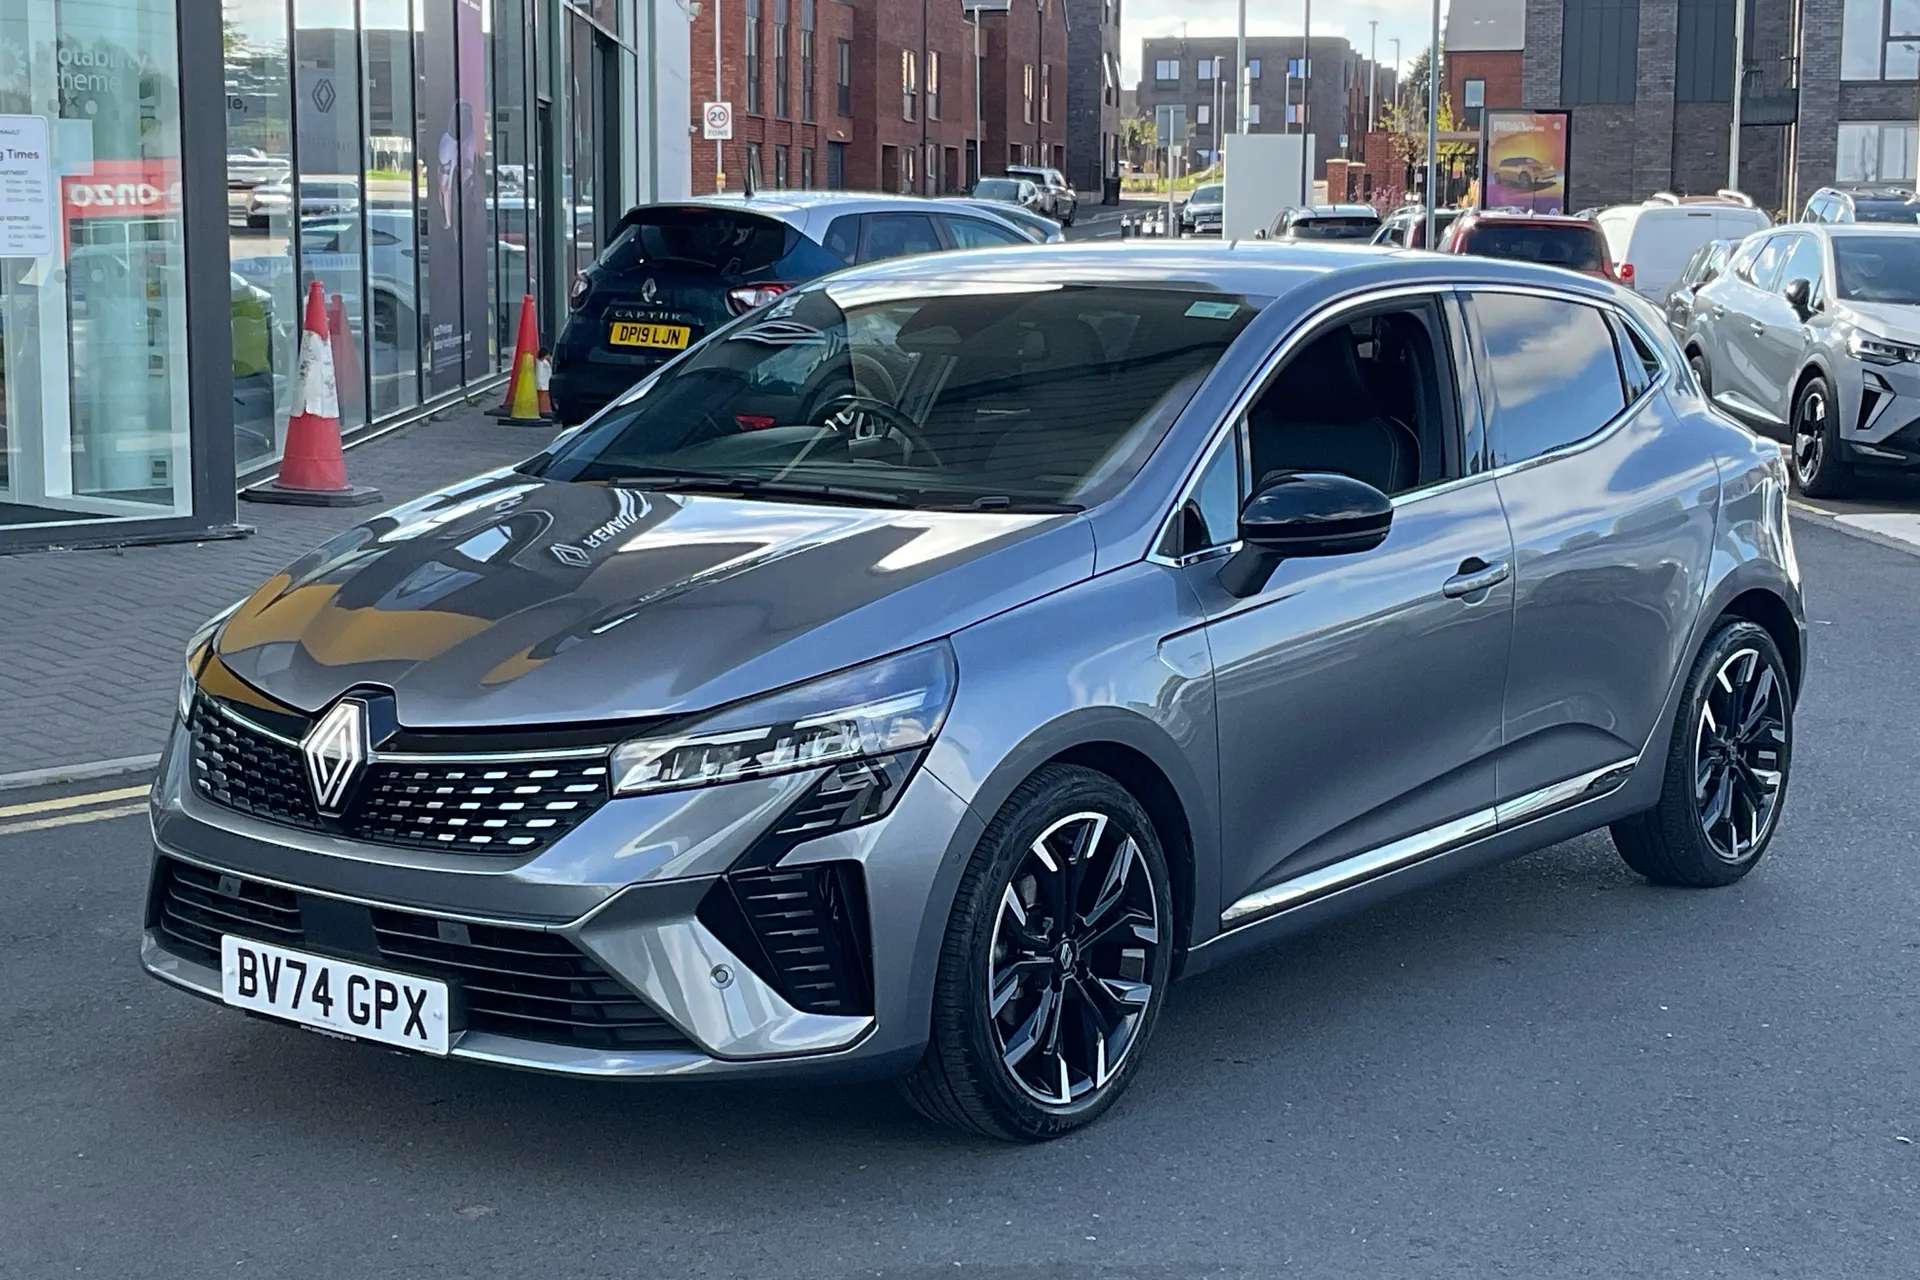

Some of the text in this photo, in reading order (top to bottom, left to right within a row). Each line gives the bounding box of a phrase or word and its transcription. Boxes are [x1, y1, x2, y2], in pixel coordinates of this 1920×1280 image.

[58, 46, 147, 75] otability
[710, 111, 726, 121] 20
[7, 149, 39, 159] Times
[615, 310, 681, 320] CAPTUR
[619, 325, 681, 345] DP19 LJN
[237, 948, 428, 1040] BV74 GPX
